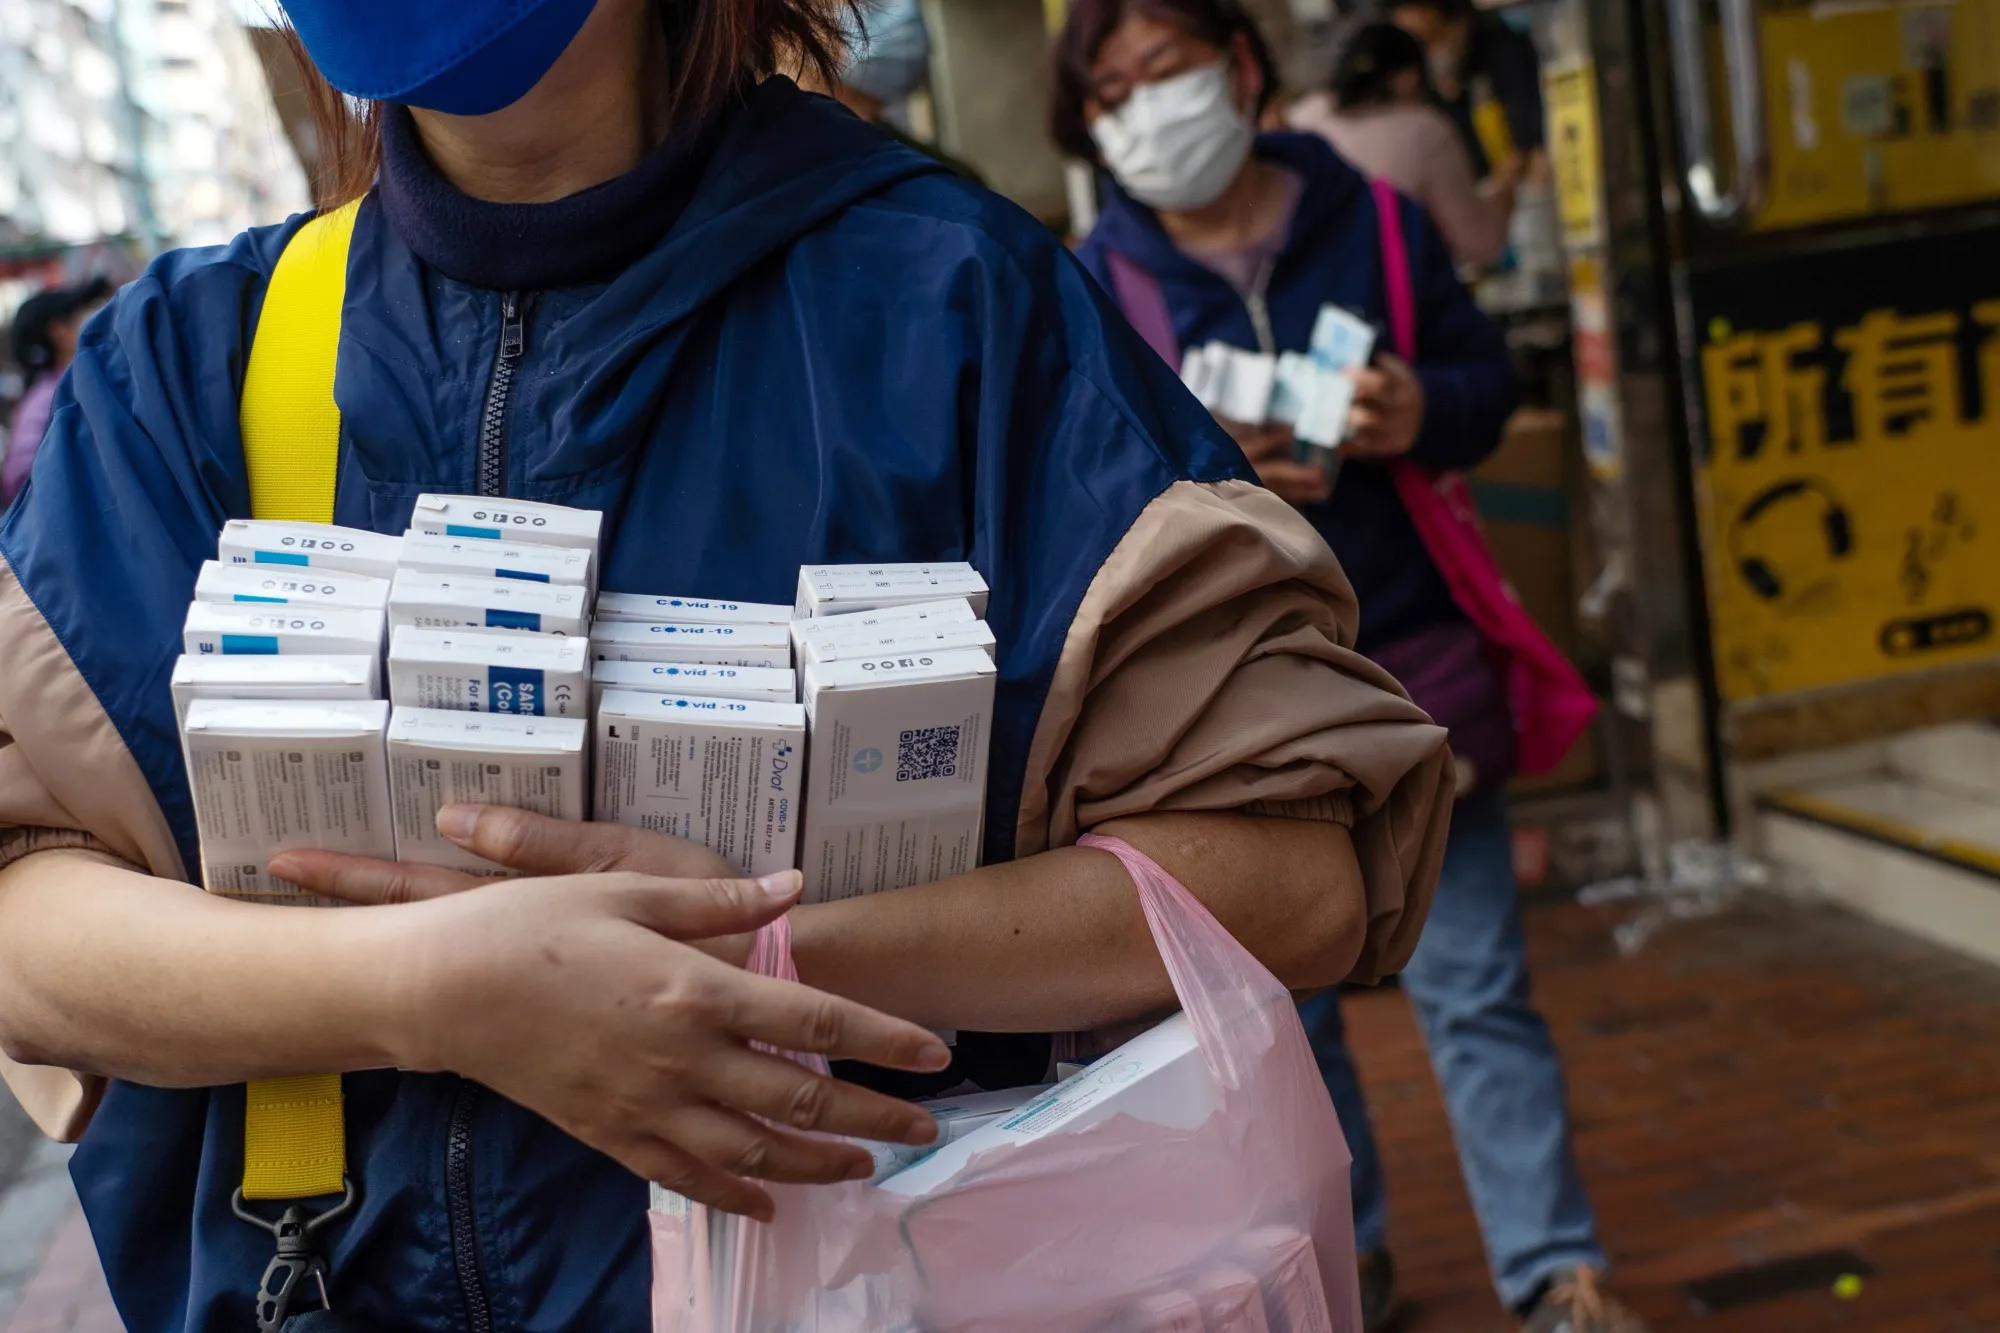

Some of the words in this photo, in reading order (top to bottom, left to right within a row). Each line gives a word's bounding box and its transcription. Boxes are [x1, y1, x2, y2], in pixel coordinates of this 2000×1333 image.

[1702, 298, 2000, 460] 所有
[469, 679, 480, 697] For
[771, 758, 788, 791] Dvot
[767, 798, 775, 822] ANTIGEN
[778, 799, 788, 832] COVID-19
